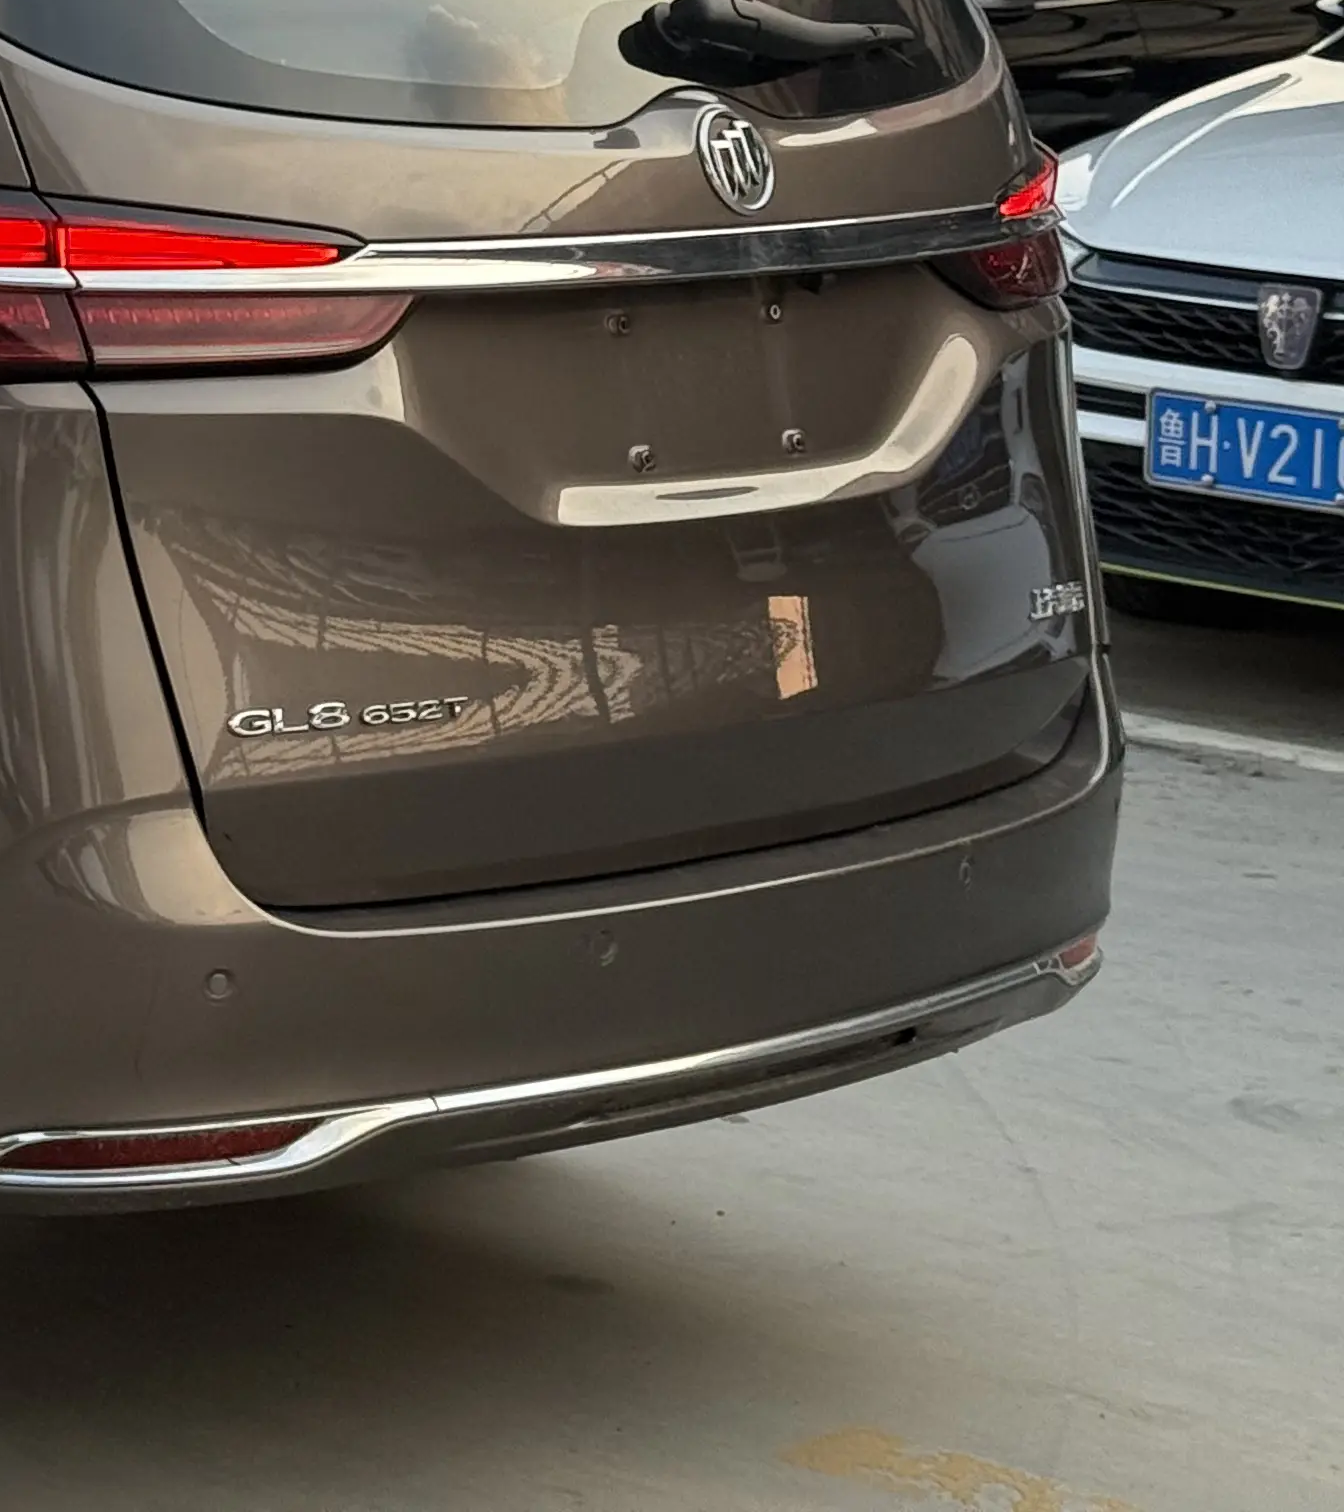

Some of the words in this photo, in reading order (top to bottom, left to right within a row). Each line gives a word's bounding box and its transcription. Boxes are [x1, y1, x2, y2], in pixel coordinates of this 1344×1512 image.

[1159, 407, 1344, 489] 鲁H·V21
[227, 691, 351, 736] GL8
[362, 696, 469, 725] 652T
